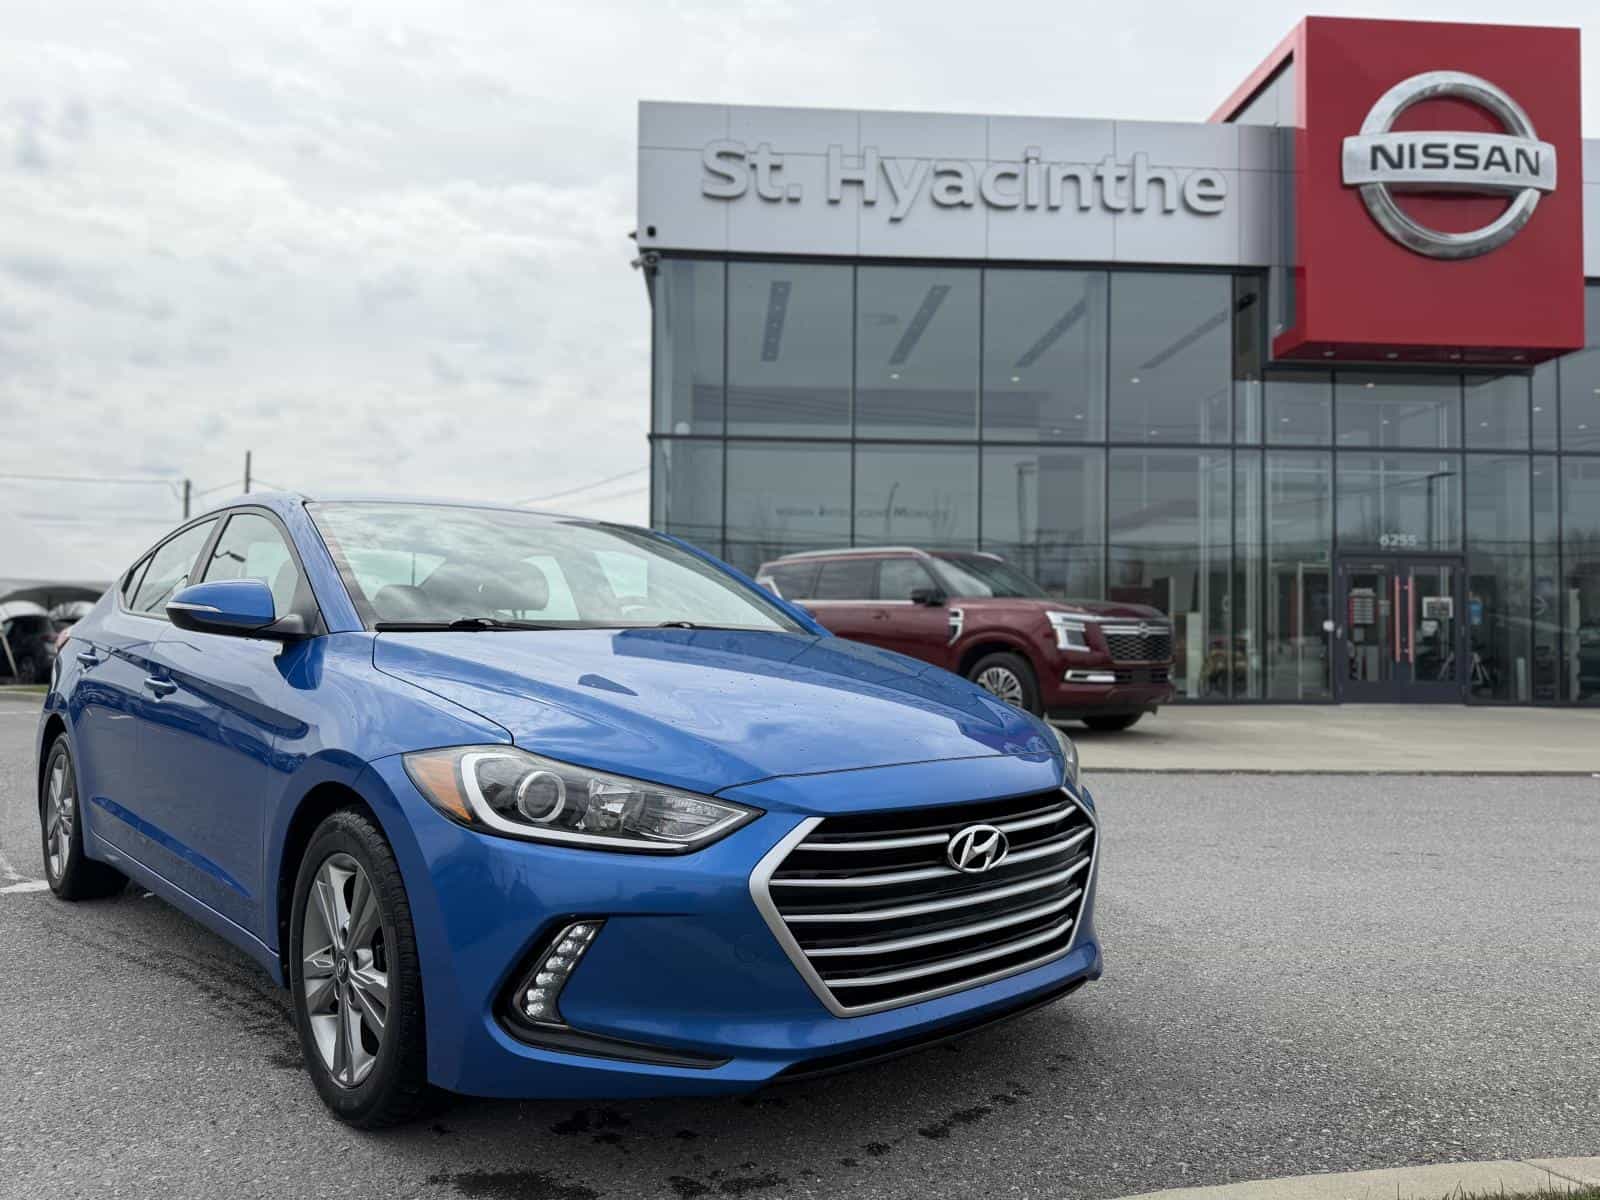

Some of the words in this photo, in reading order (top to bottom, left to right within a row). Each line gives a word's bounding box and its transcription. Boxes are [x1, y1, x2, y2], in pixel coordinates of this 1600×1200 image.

[1370, 143, 1541, 177] NISSAN
[702, 138, 802, 201] St.
[826, 144, 1228, 222] Hyacinthe
[1379, 534, 1417, 546] 6255
